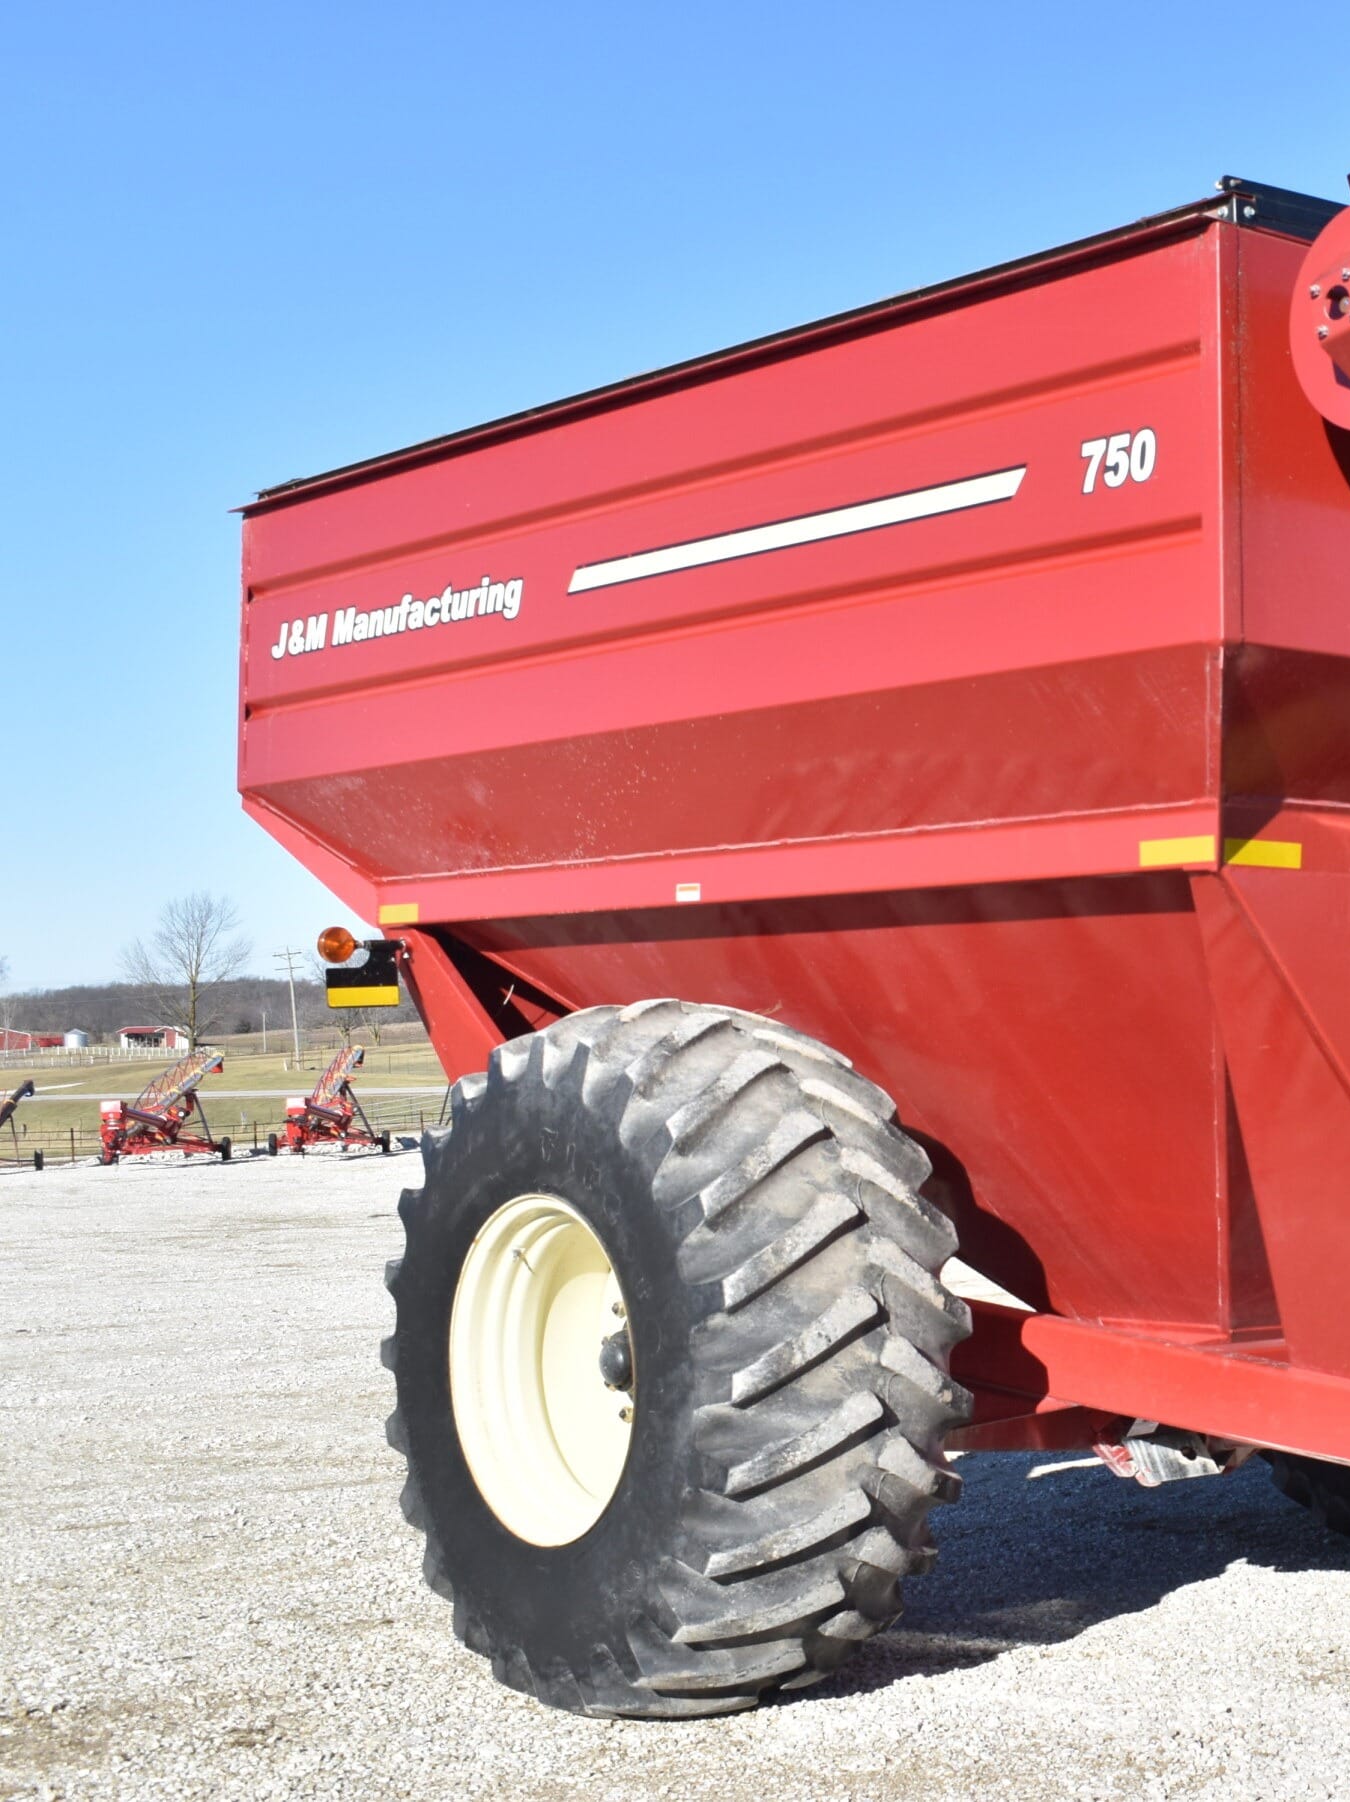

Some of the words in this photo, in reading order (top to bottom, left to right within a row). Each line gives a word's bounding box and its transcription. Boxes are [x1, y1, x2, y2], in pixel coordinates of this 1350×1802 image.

[1080, 426, 1157, 495] 750
[270, 613, 328, 660] J&M
[331, 575, 524, 646] Manufacturing
